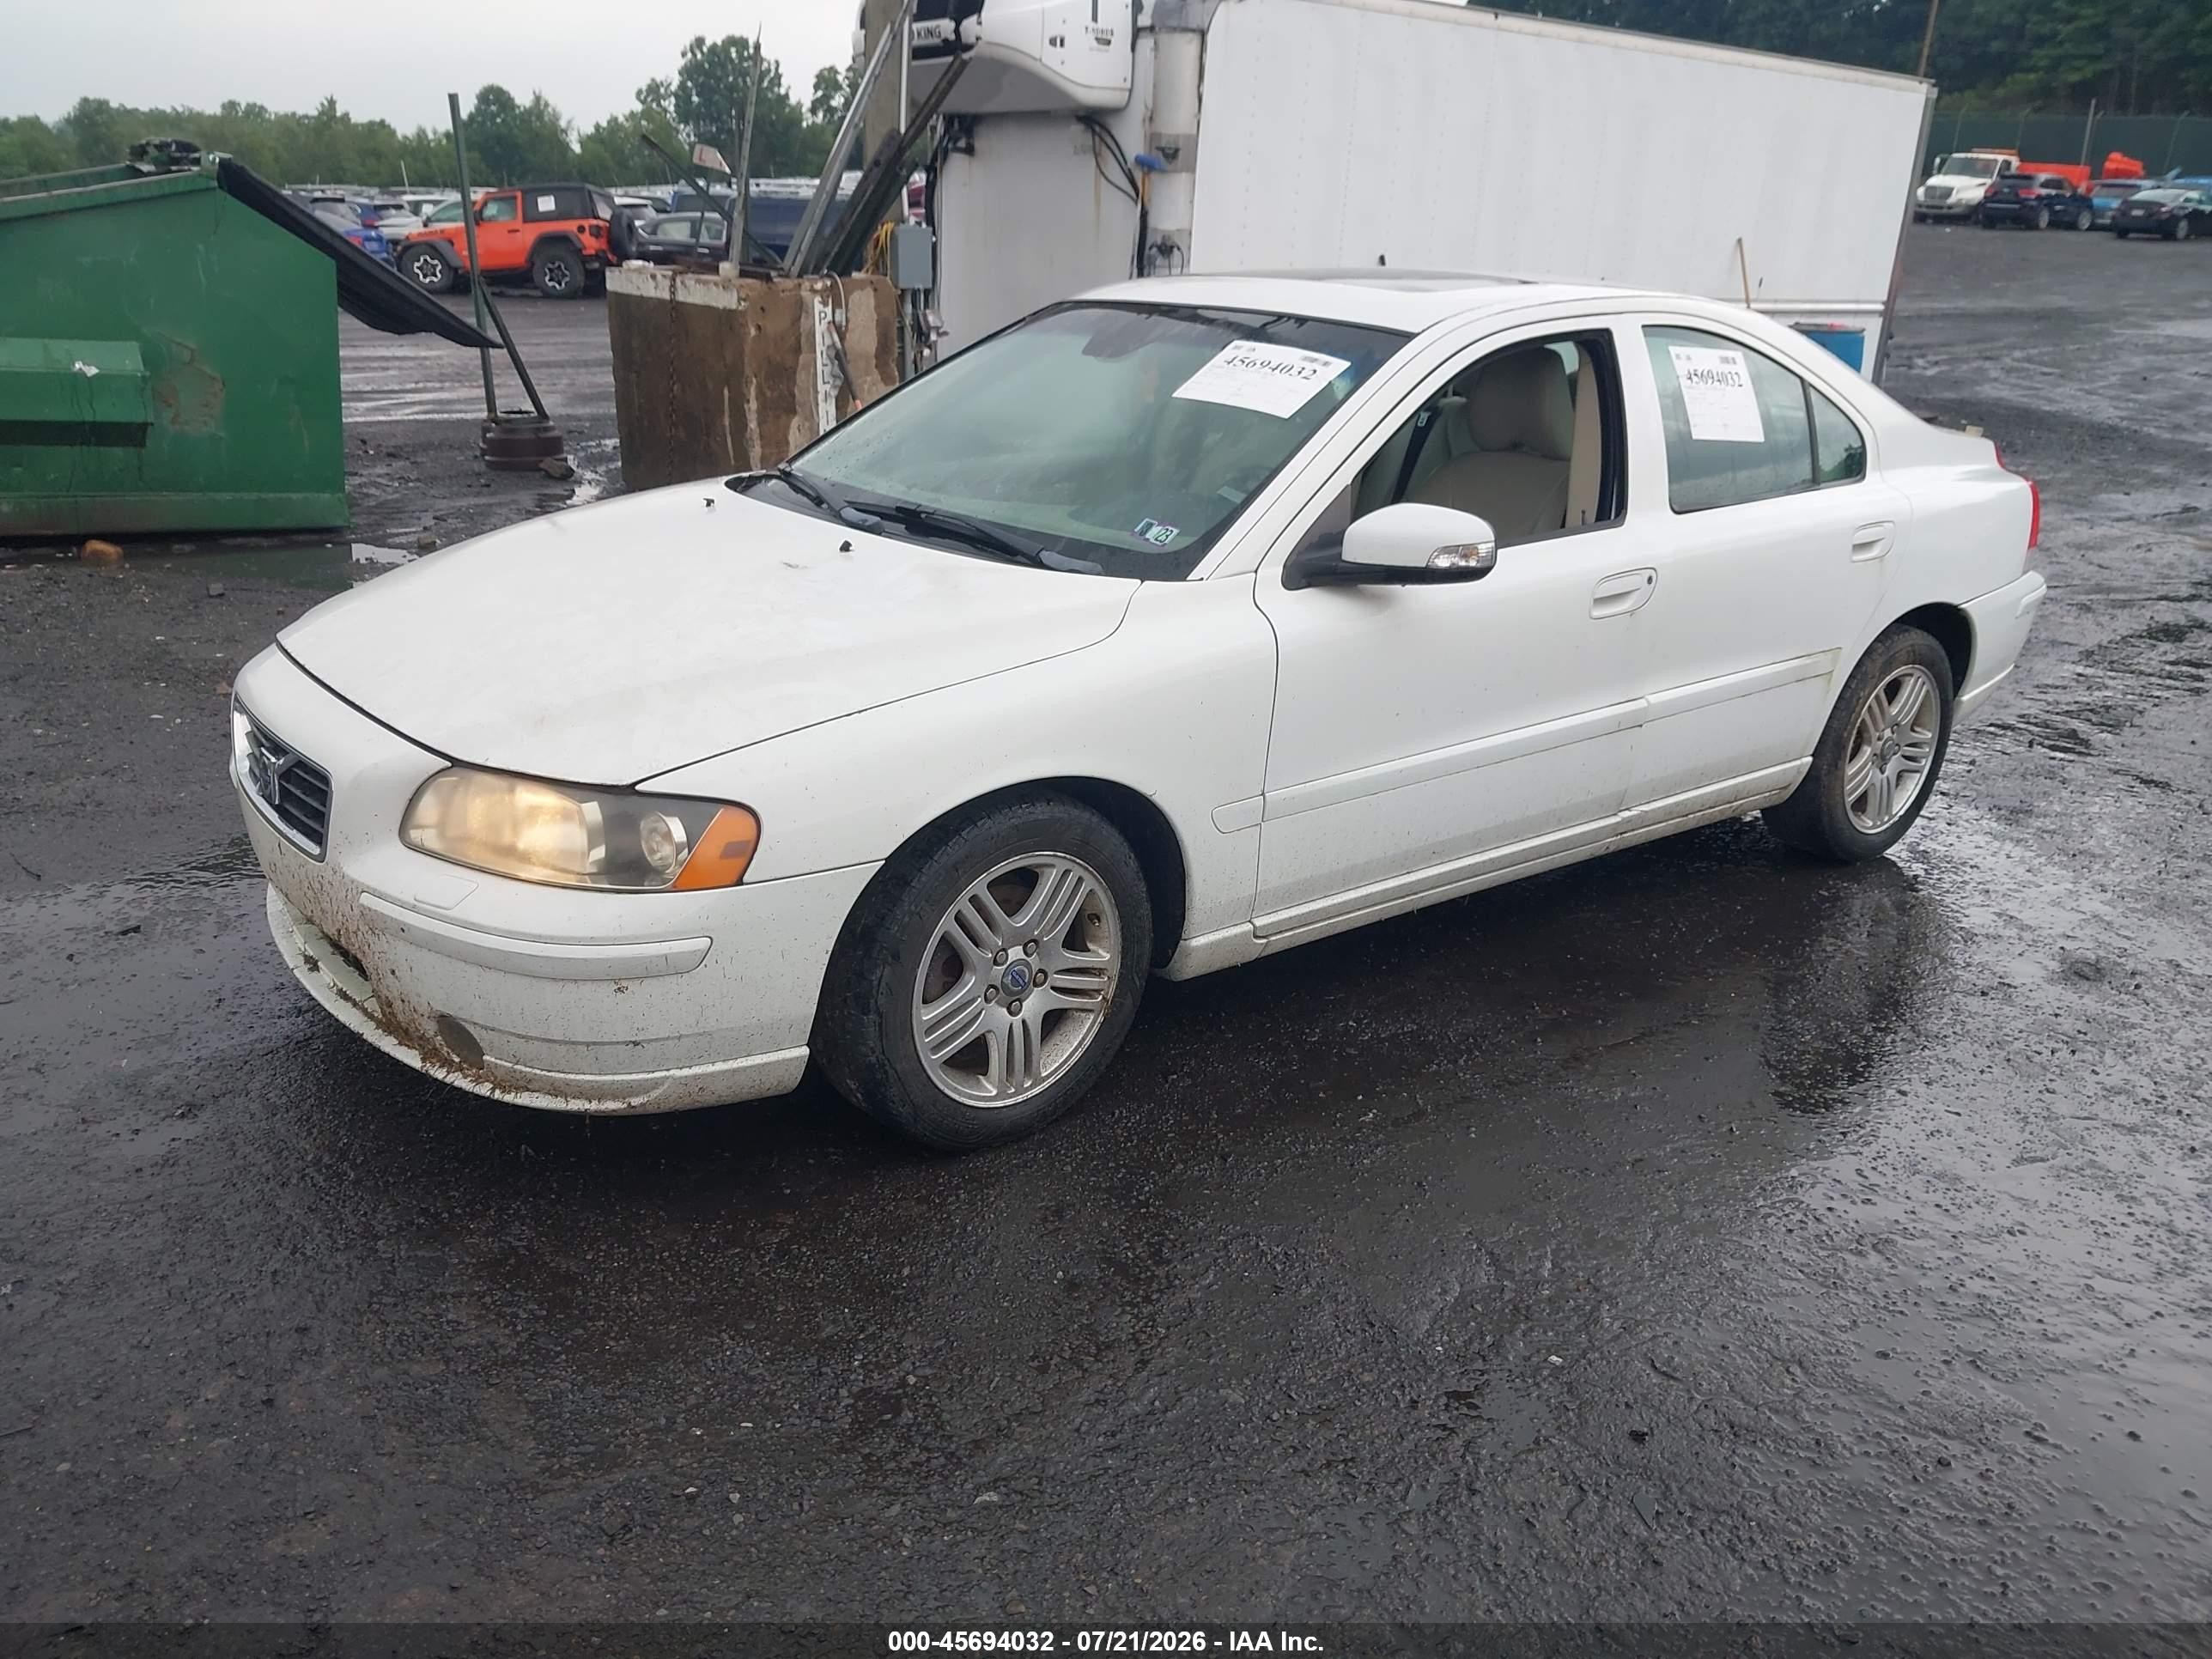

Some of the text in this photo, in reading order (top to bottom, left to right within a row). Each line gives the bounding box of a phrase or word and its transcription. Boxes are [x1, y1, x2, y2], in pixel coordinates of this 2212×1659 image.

[916, 25, 942, 40] KING
[1224, 355, 1318, 380] 45694032
[1686, 368, 1744, 387] 45694032
